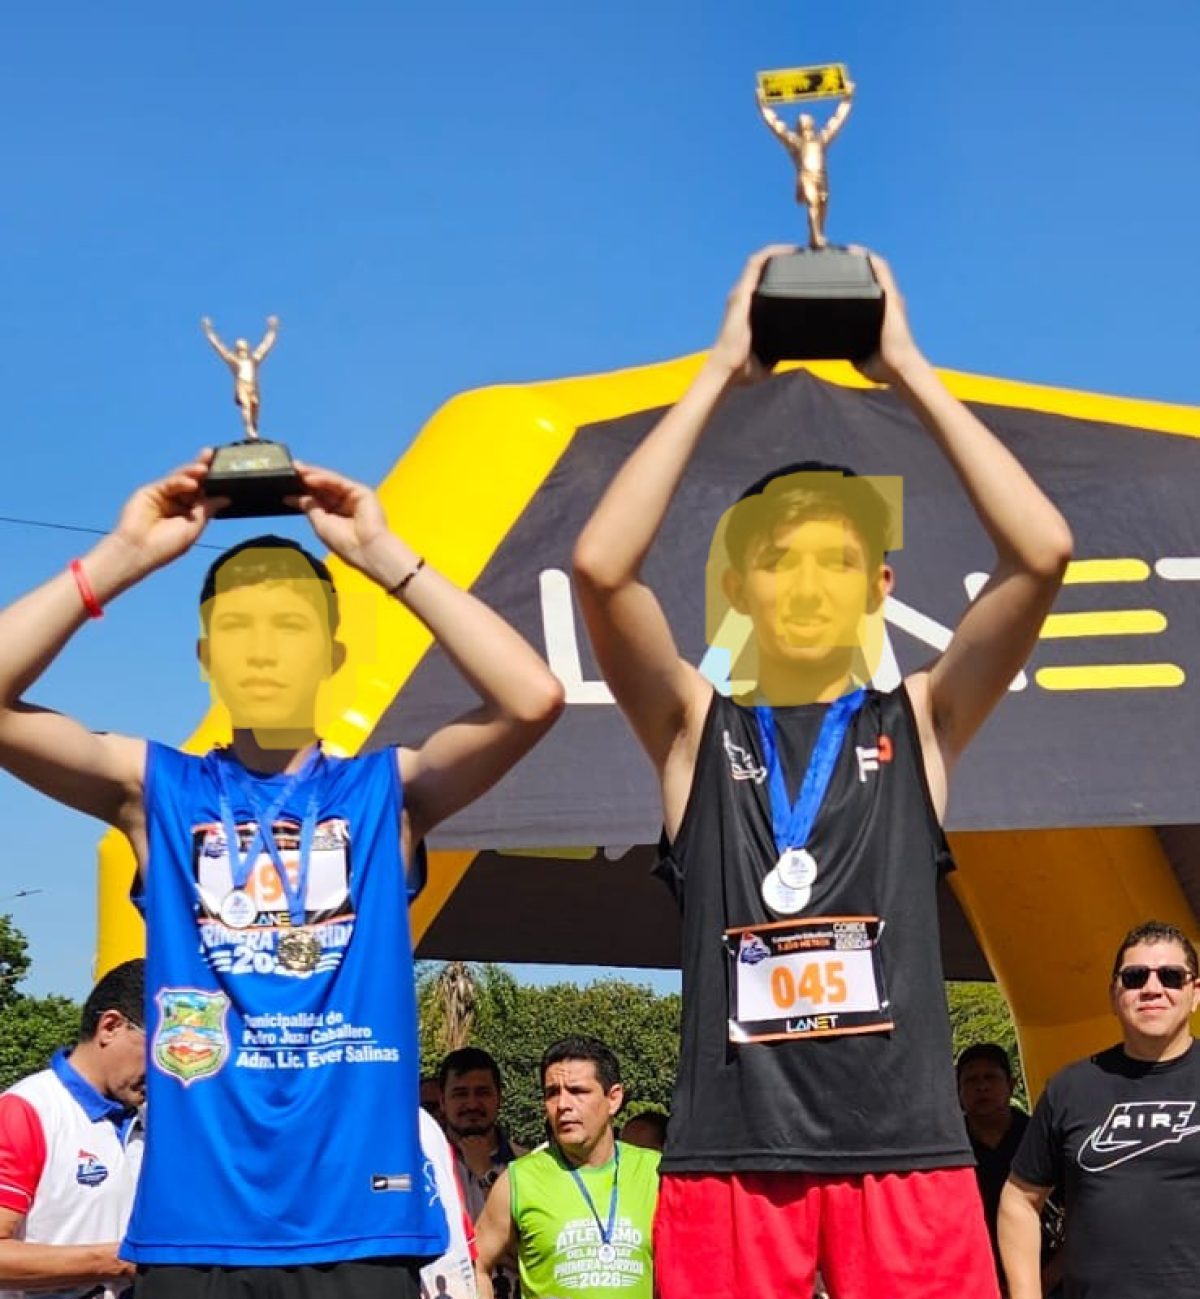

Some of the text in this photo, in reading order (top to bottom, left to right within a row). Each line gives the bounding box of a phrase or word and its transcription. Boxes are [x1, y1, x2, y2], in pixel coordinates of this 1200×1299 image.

[257, 911, 291, 925] ANE
[771, 961, 847, 1010] 045
[786, 1014, 839, 1033] LANET
[236, 1045, 400, 1069] Adm. Lic. Ever Salinas
[1112, 1113, 1172, 1129] AIR
